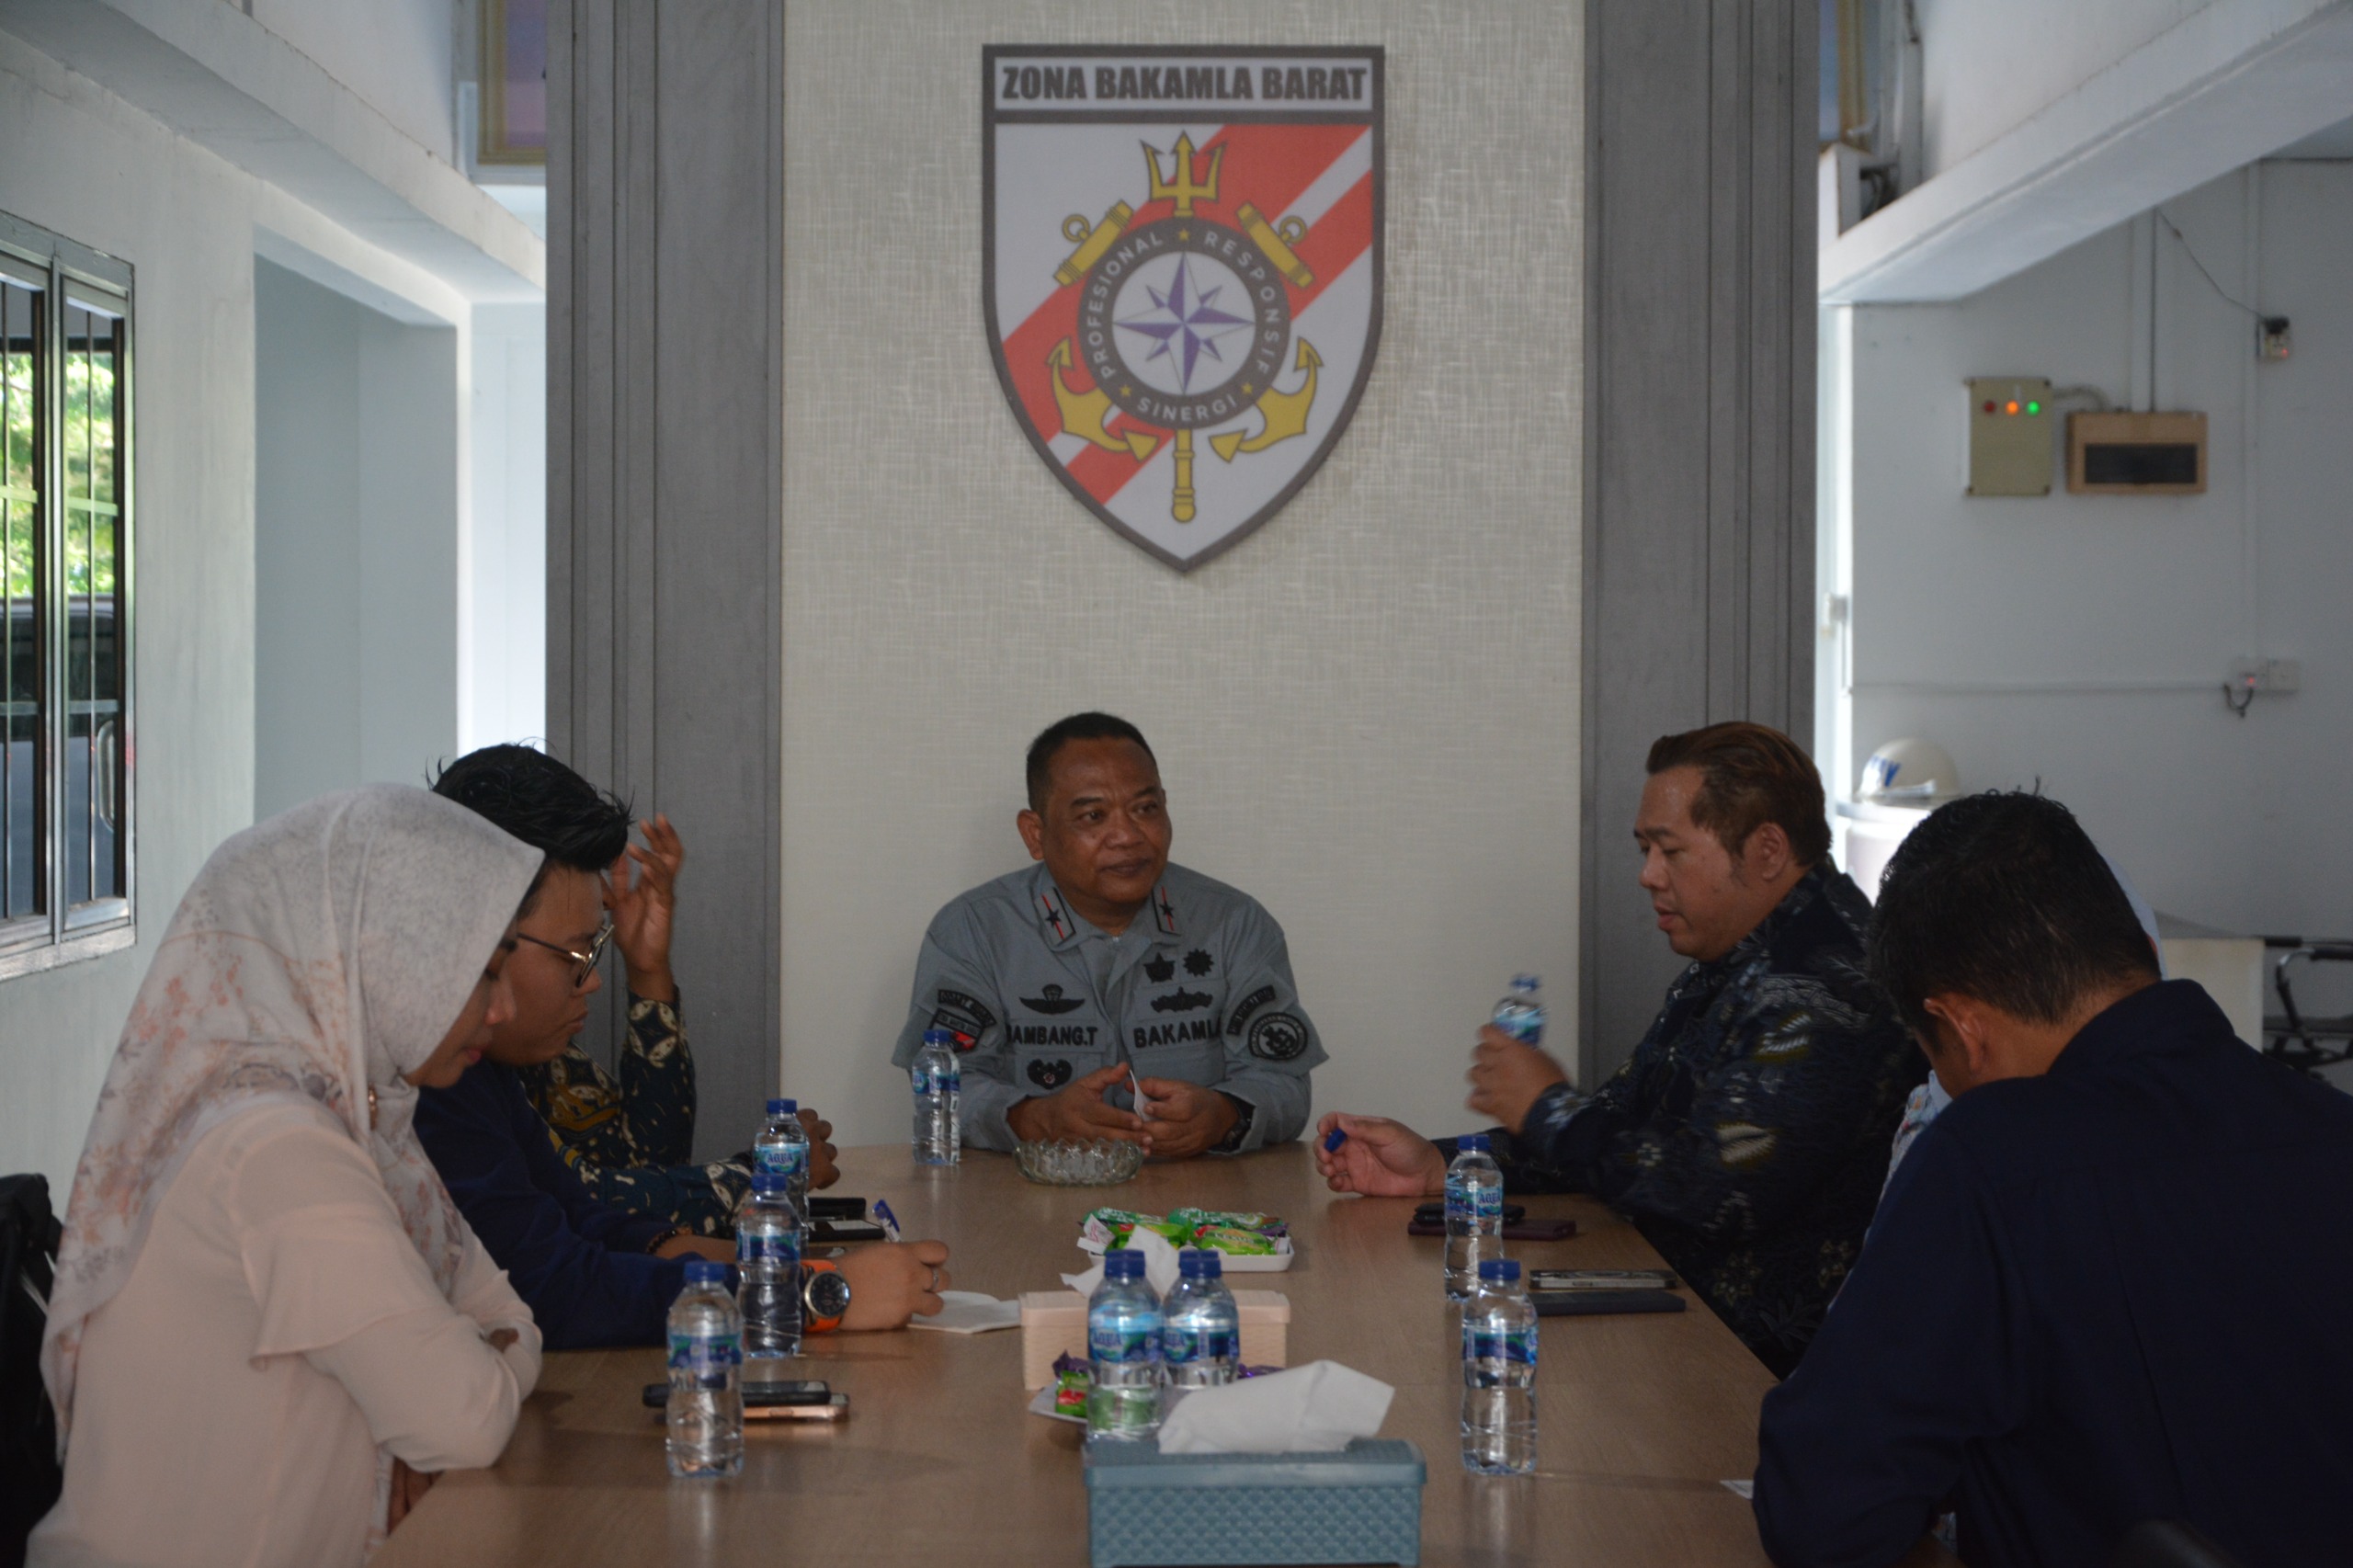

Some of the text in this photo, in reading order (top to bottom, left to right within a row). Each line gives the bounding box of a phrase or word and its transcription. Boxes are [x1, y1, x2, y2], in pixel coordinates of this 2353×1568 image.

[1002, 65, 1368, 101] ZONA BAKAMLA BARAT
[1087, 232, 1163, 380] PROFESIONAL
[1204, 231, 1279, 374] RESPONSIF
[1137, 393, 1238, 422] SINERGI
[767, 1153, 794, 1164] AQUA
